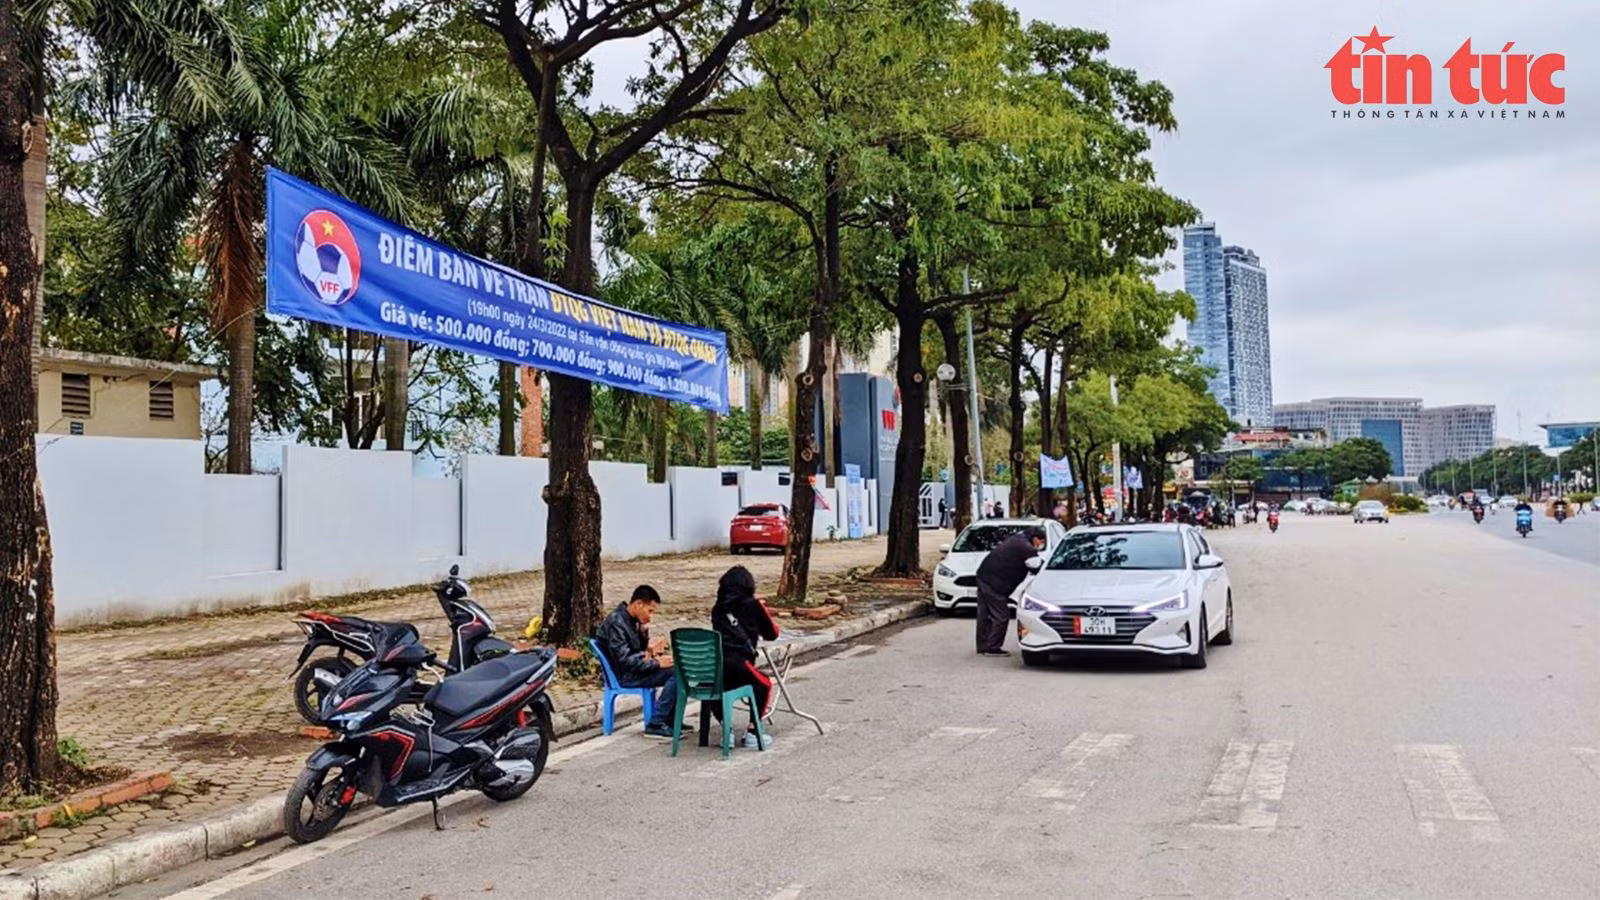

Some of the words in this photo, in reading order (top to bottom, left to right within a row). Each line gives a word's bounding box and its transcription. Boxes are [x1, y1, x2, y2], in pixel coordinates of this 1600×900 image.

[320, 280, 339, 294] VFF
[467, 298, 500, 320] (19h00
[503, 311, 525, 330] ngày
[380, 301, 407, 325] Giá
[409, 310, 433, 331] vé:
[436, 315, 492, 344] 500.000
[494, 328, 530, 357] đồng;
[532, 338, 576, 365] 700.000
[607, 358, 642, 382] 900.000
